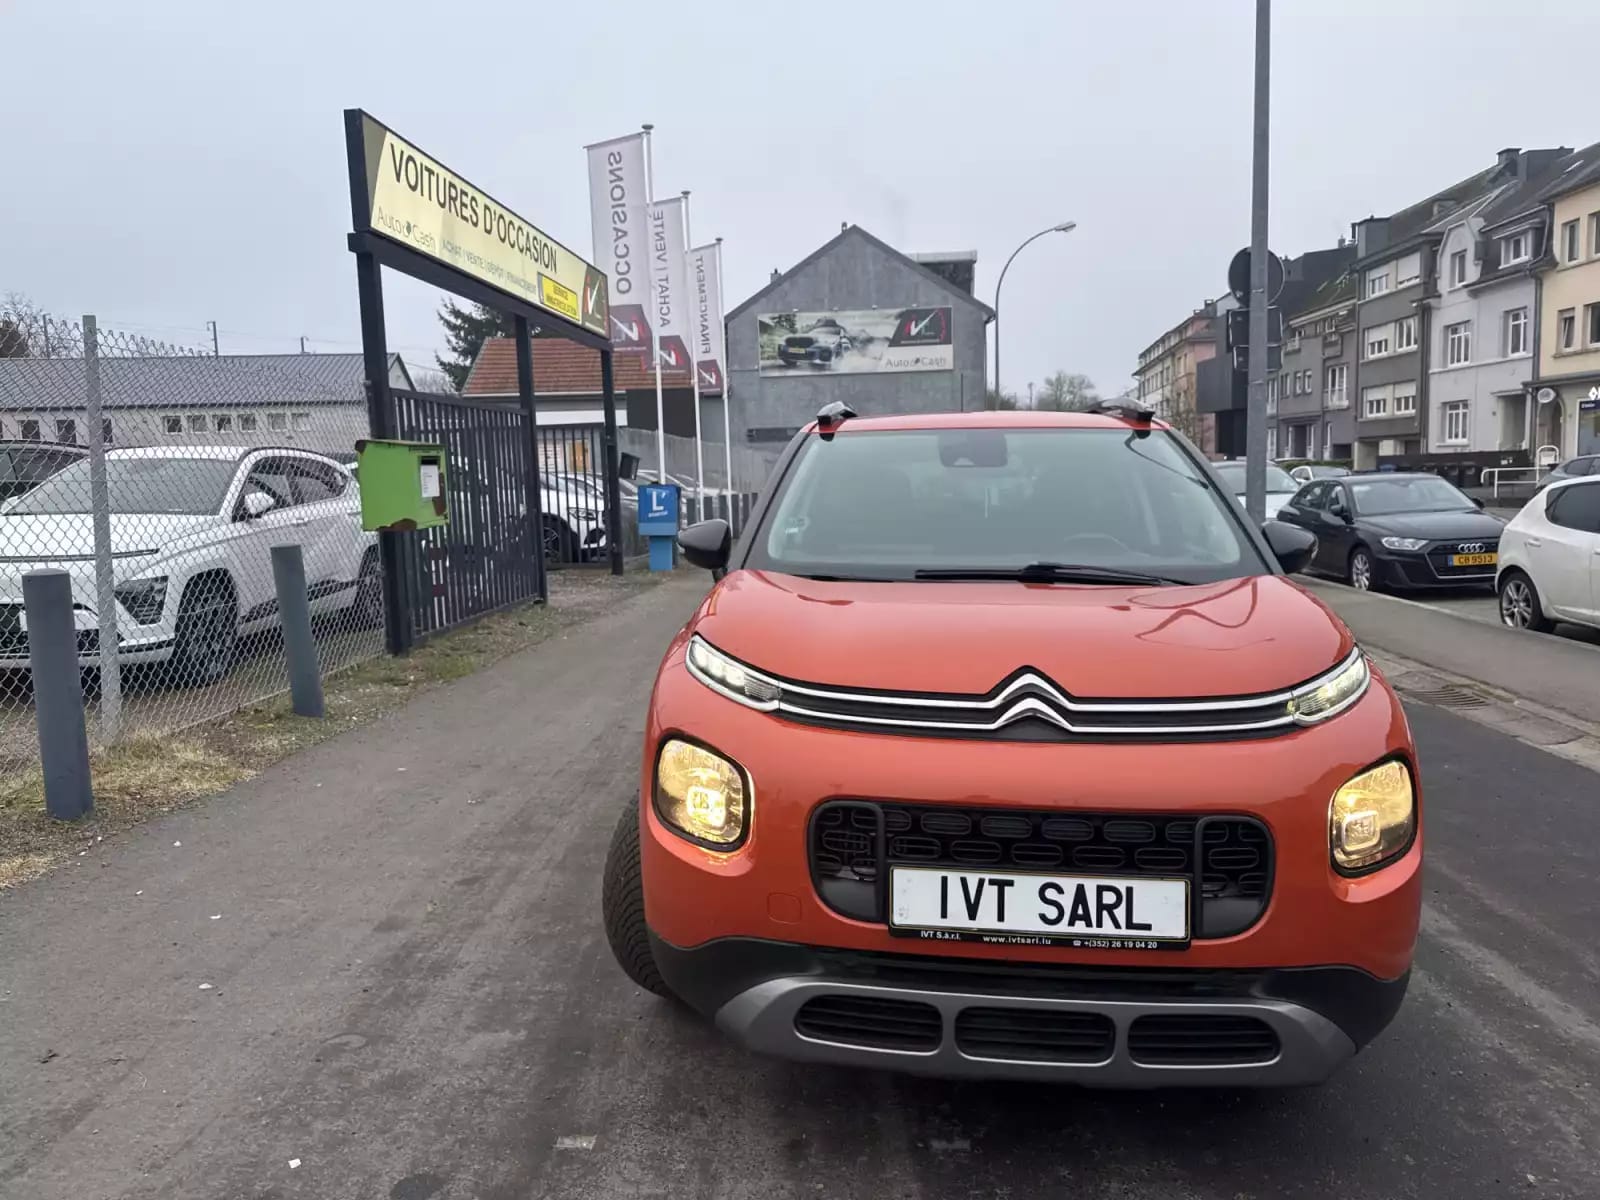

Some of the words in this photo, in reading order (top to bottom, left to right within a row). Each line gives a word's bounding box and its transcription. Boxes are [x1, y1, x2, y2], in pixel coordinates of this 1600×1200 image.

[390, 142, 479, 228] VOITURES
[483, 203, 558, 273] D'OCCASION
[886, 358, 910, 369] Auto
[921, 357, 946, 369] Cash
[940, 875, 1015, 923] IVT
[1038, 881, 1153, 932] SARL
[920, 930, 934, 938] IVT
[1084, 940, 1110, 948] +(352)
[1147, 941, 1157, 949] 20
